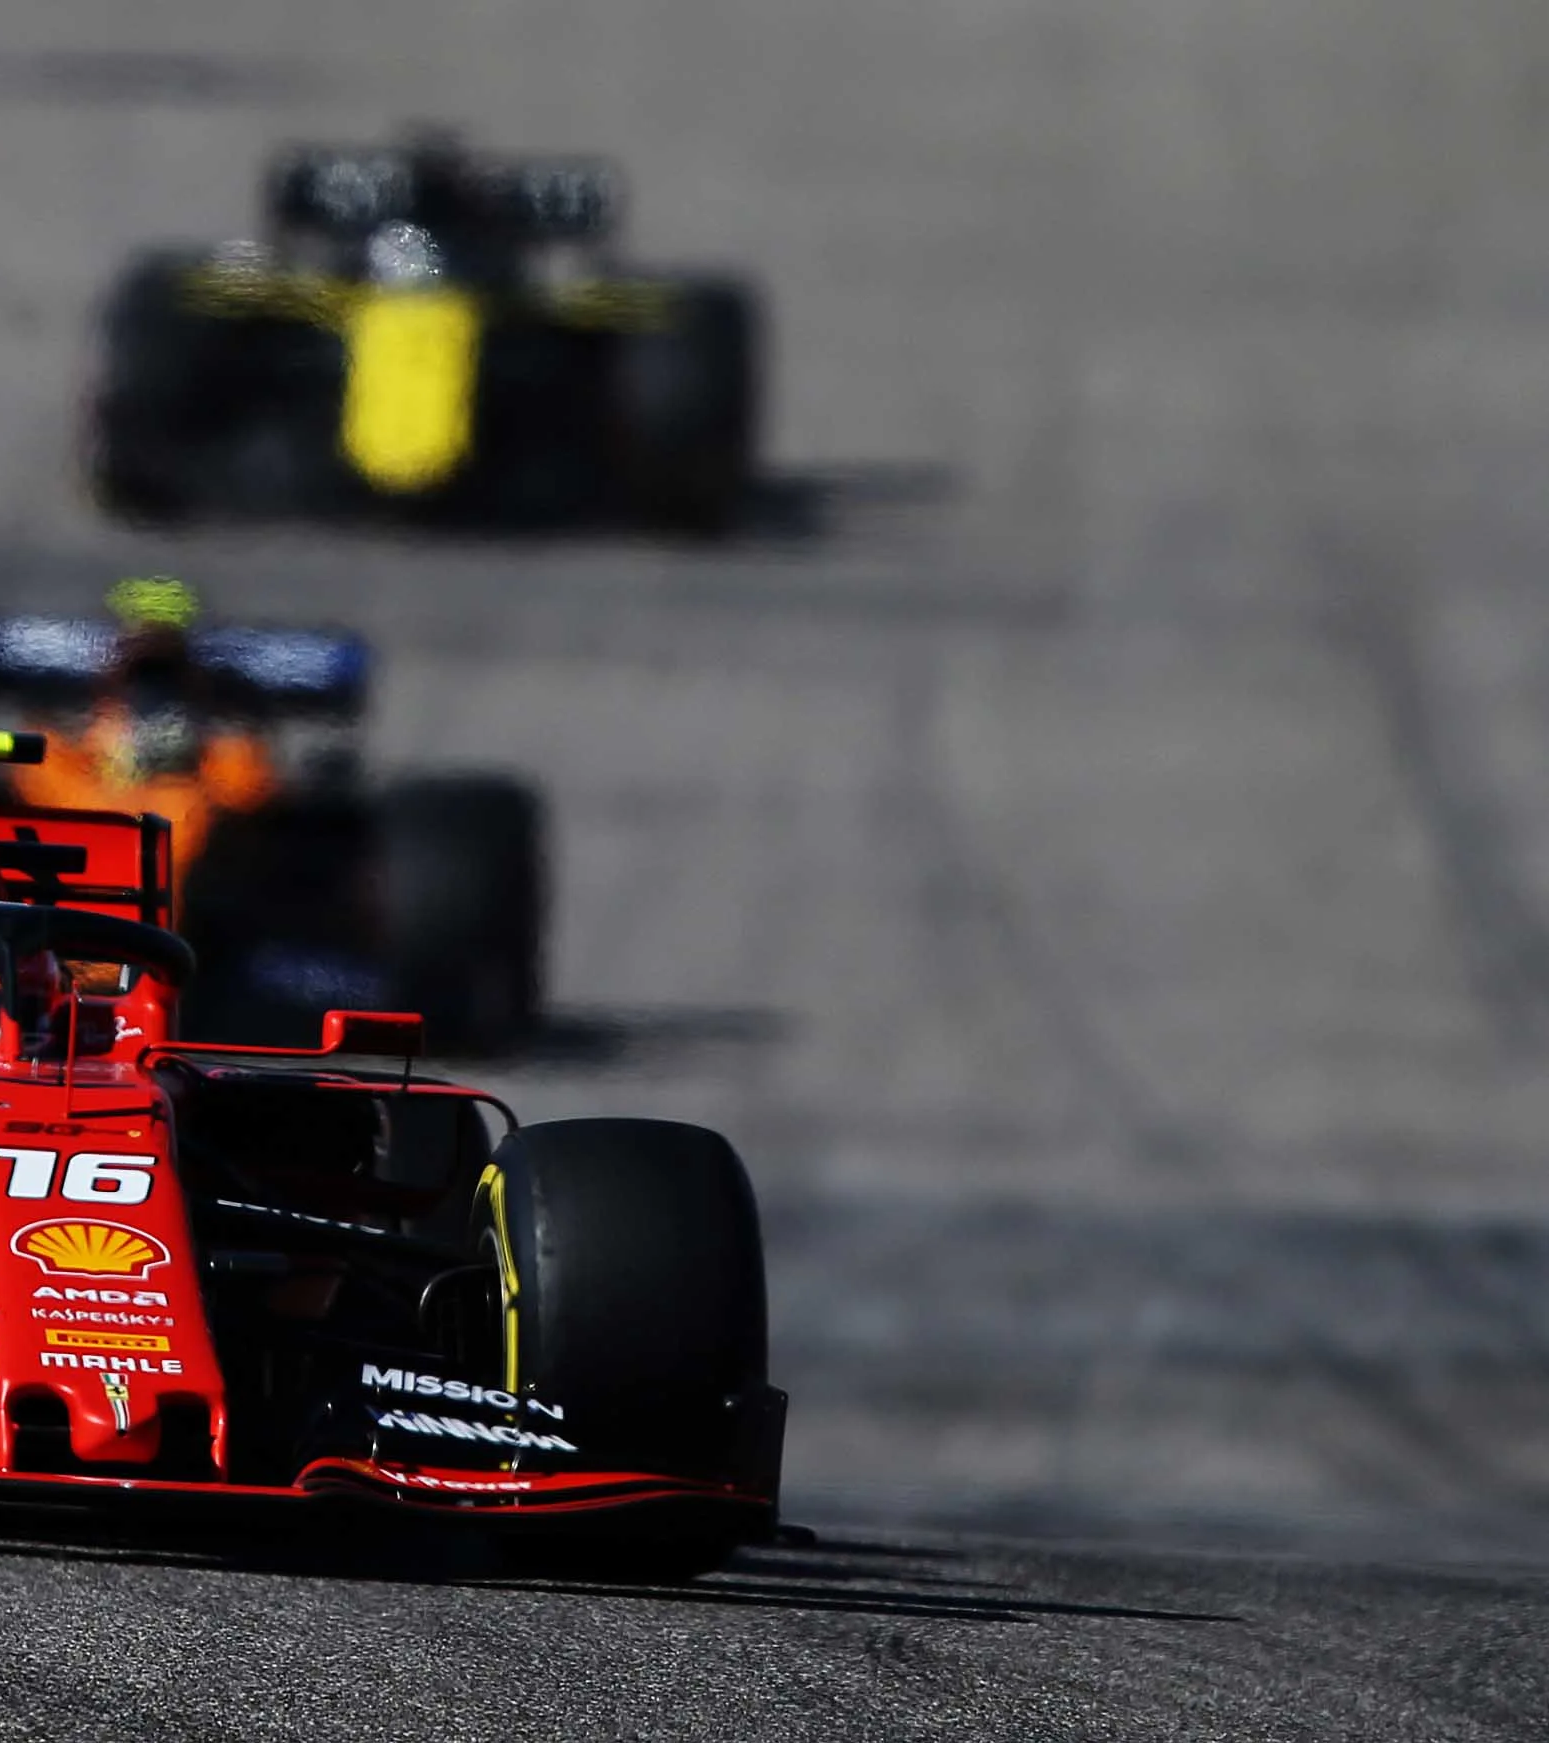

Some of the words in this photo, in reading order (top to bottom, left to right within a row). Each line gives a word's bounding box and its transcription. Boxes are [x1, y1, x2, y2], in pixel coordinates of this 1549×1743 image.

[31, 1308, 161, 1326] KASPERSKY
[41, 1352, 183, 1374] MAHLE
[361, 1363, 564, 1420] MISSION
